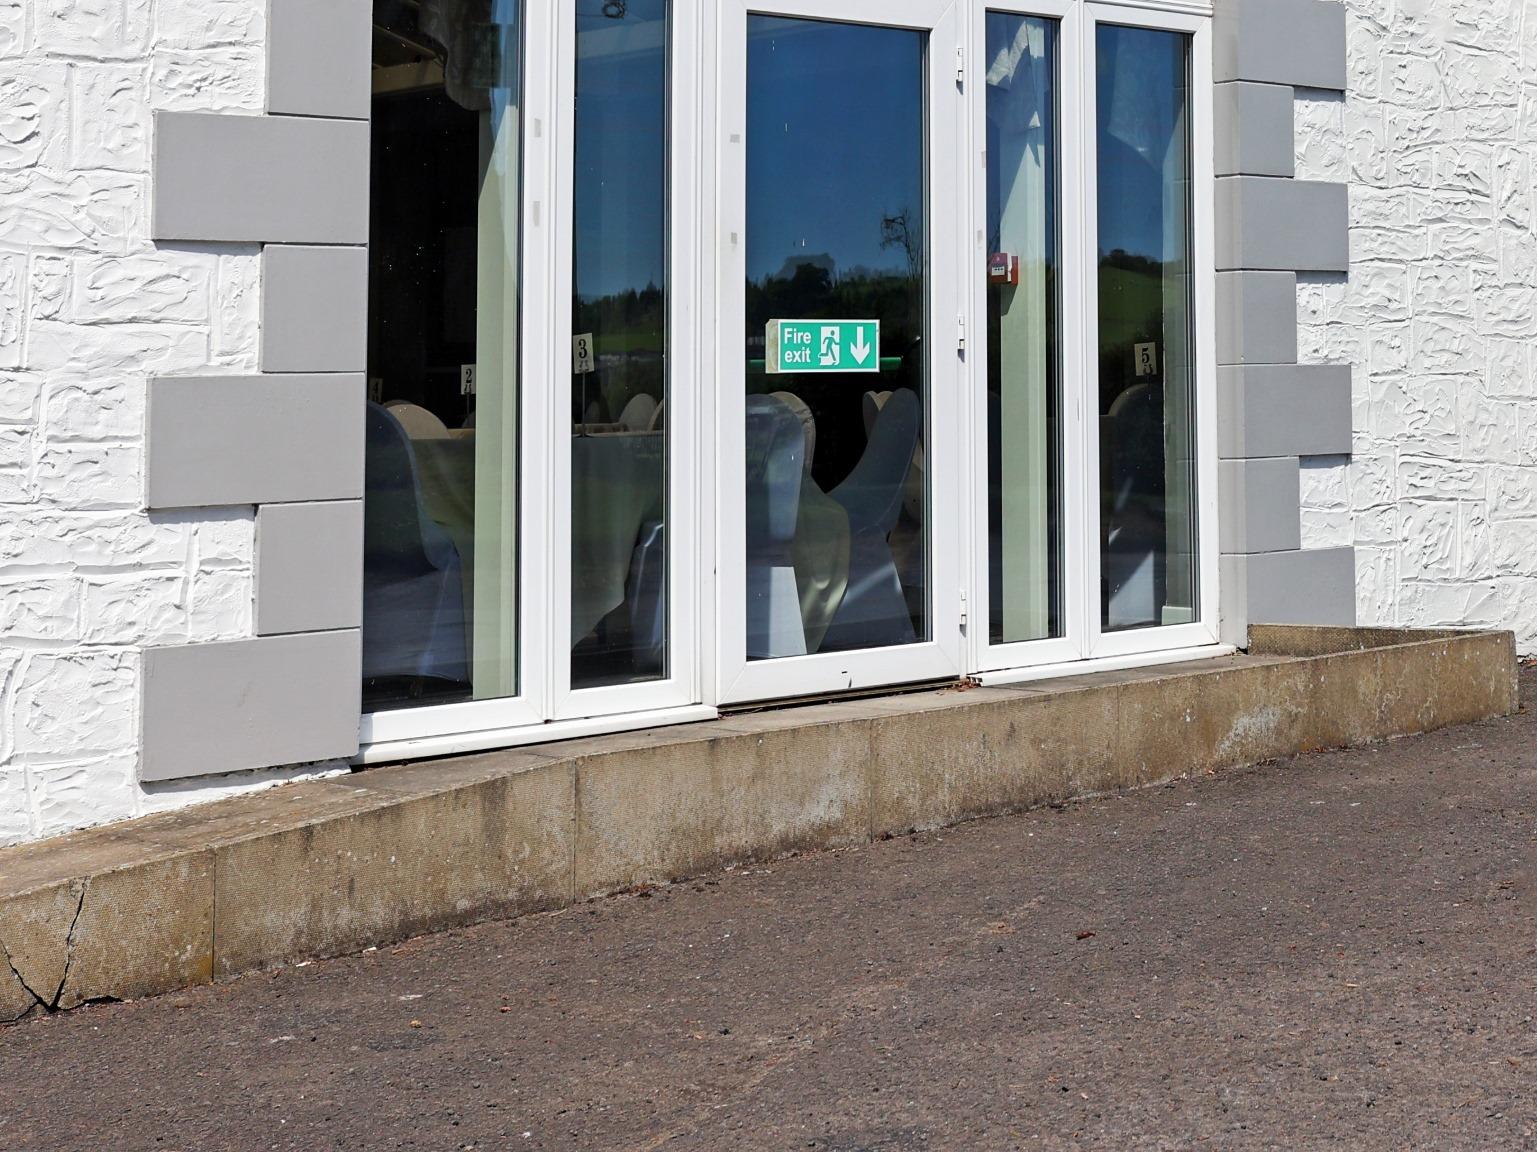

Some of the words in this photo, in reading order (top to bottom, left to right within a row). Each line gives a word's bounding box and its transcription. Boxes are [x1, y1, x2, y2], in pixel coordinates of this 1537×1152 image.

[784, 328, 811, 344] Fire
[578, 339, 587, 358] 3
[784, 347, 811, 362] exit
[1142, 348, 1149, 363] 5
[465, 368, 472, 383] 2
